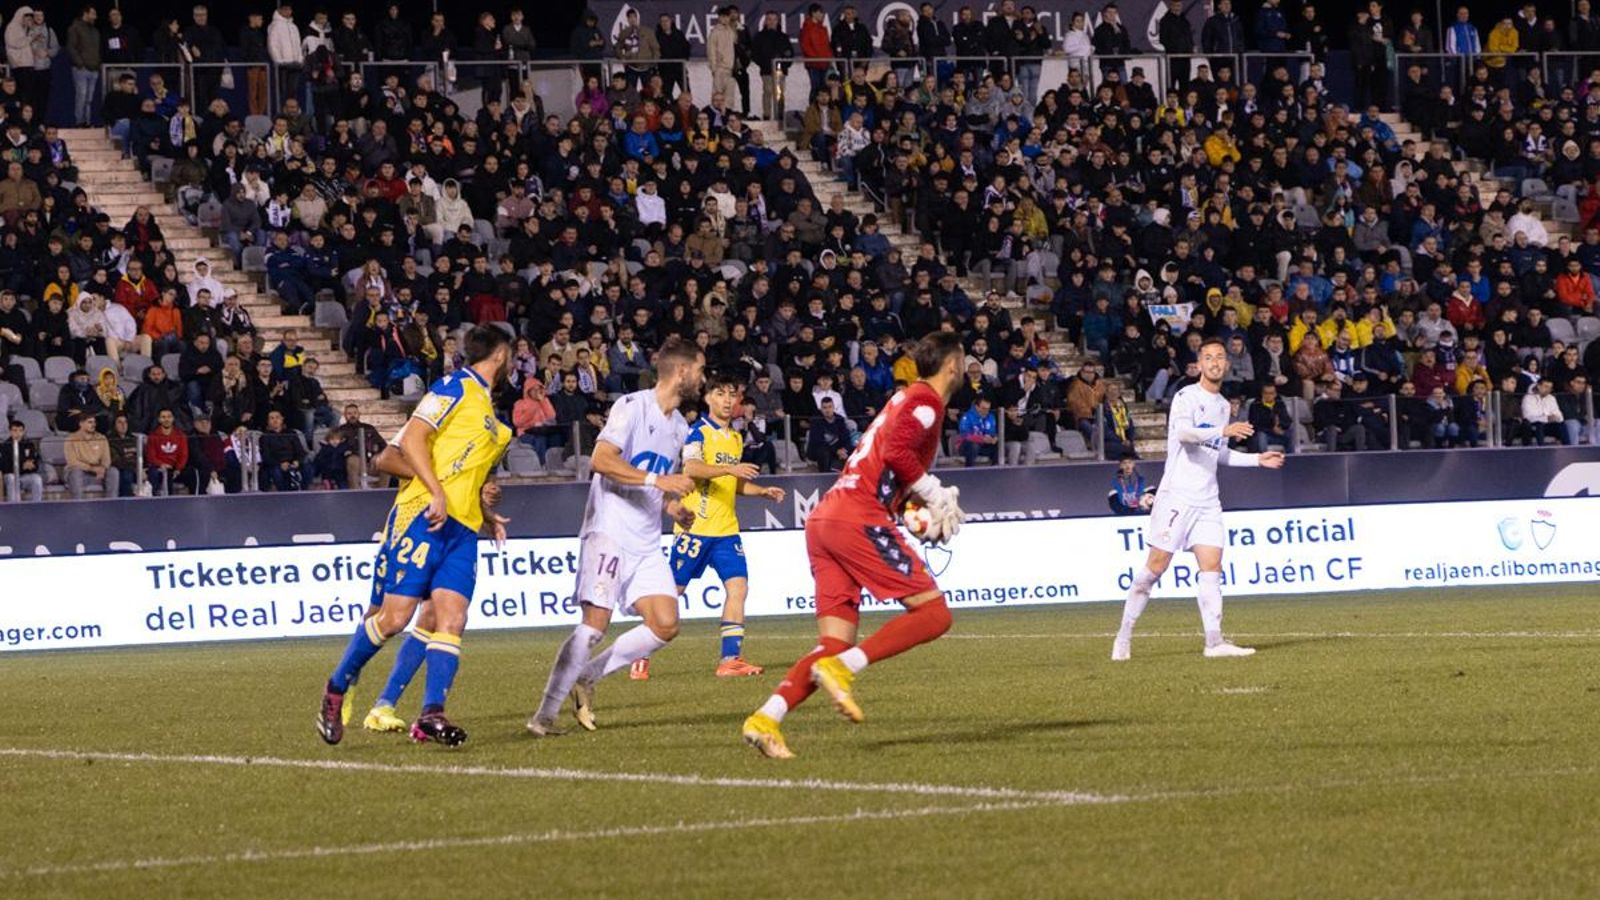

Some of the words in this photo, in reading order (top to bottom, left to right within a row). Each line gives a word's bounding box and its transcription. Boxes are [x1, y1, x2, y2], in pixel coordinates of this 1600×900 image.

[675, 5, 746, 44] AÉ
[1170, 509, 1179, 527] 7
[1266, 517, 1355, 544] oficial
[397, 537, 430, 569] 24
[676, 534, 702, 558] 33
[146, 561, 300, 589] Ticketera
[312, 556, 377, 582] ofic
[481, 550, 577, 576] Ticket
[599, 553, 619, 579] 14
[1173, 562, 1236, 588] Rl
[1248, 558, 1315, 584] Jaén
[1326, 557, 1362, 580] CF
[481, 591, 527, 617] del
[540, 592, 577, 615] Re
[702, 585, 722, 609] C
[146, 605, 195, 631] del
[208, 601, 278, 628] Real
[291, 597, 364, 625] Jaén
